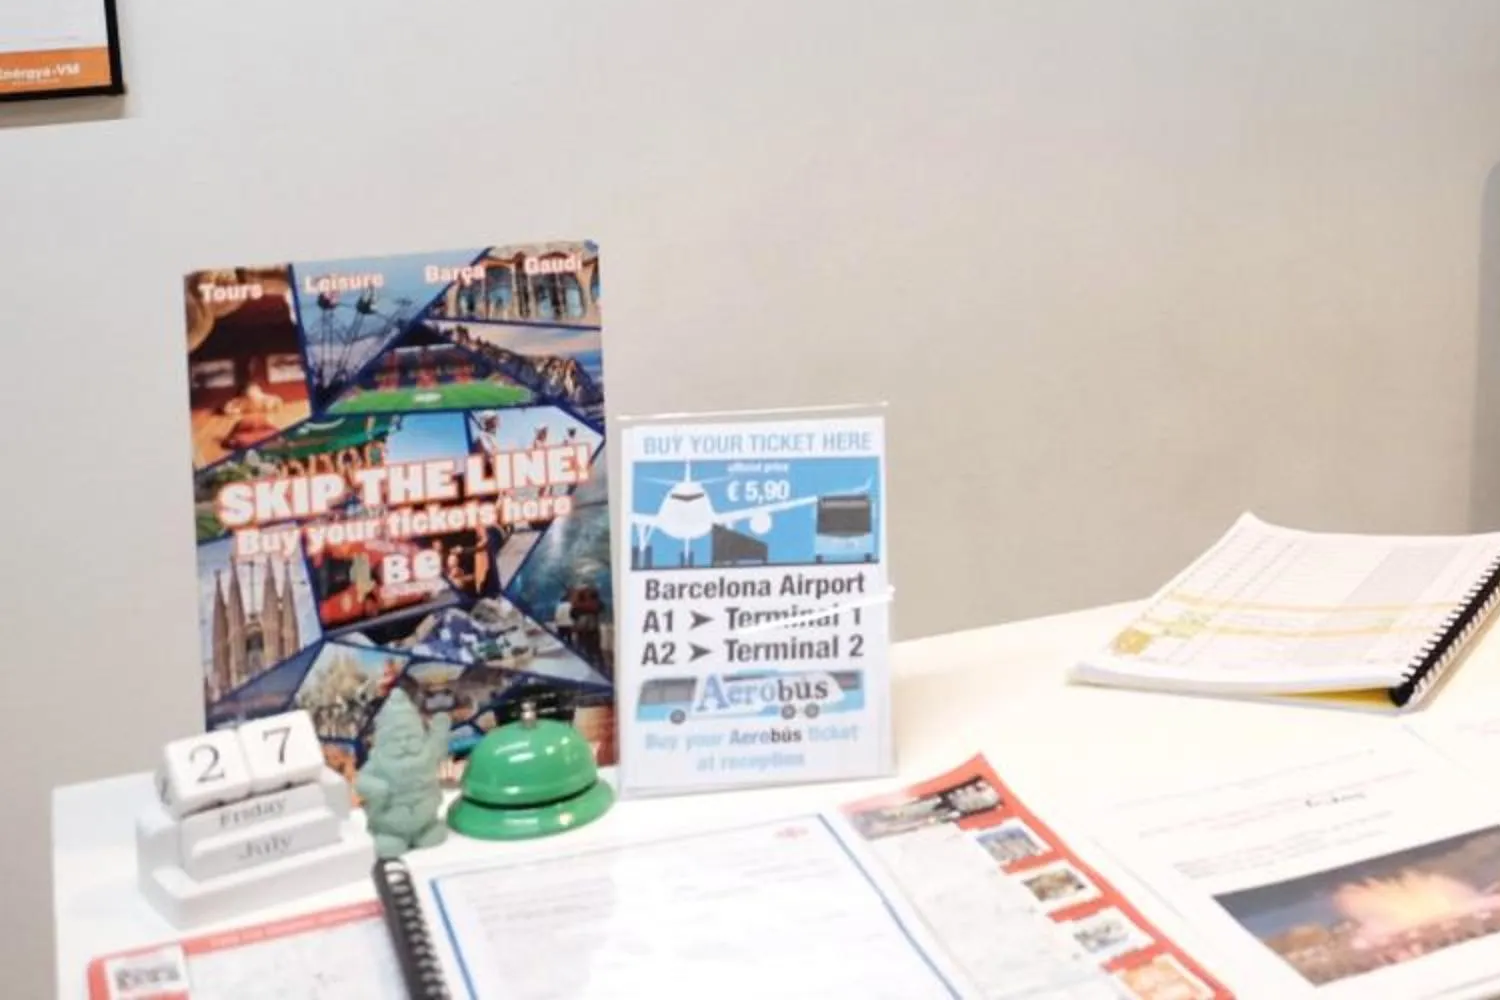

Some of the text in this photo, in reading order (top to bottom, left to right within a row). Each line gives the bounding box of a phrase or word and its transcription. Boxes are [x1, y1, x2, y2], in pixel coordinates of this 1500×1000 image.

[199, 283, 264, 301] Tours
[304, 271, 385, 294] Leisure
[424, 263, 486, 286] Barça
[643, 430, 873, 455] BUY YOUR TICKET HERE
[218, 442, 592, 529] SKIP THE LINE!
[745, 479, 791, 503] 5,90
[236, 494, 573, 556] Buy your tickets here
[644, 572, 865, 601] Barcelona Airport
[642, 609, 673, 633] A1
[641, 634, 864, 665] A2 Terminal 2
[645, 734, 678, 752] Buy
[808, 724, 859, 742] ticket
[721, 750, 805, 770] reception
[219, 799, 287, 828] Friday
[238, 834, 292, 859] July
